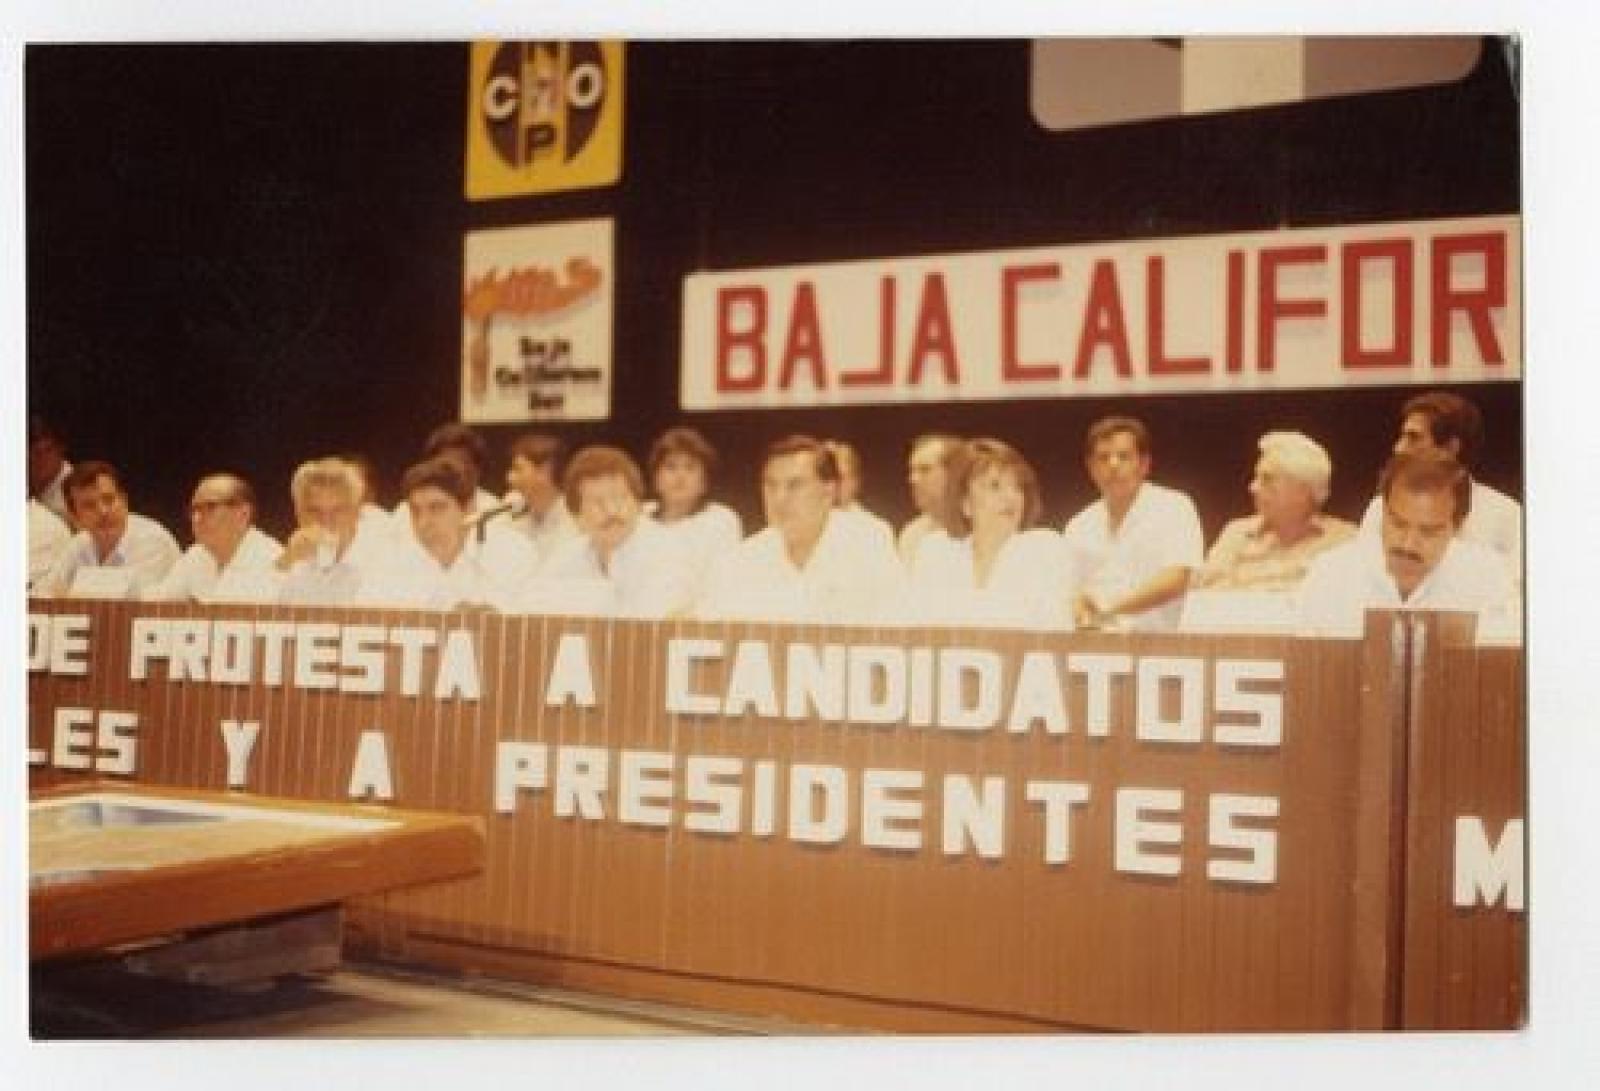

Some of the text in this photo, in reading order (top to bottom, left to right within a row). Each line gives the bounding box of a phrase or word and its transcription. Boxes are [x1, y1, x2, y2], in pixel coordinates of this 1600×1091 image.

[716, 231, 1506, 393] BAJA CALIFOR
[130, 617, 481, 700] PROTESTA
[546, 634, 597, 707] A
[665, 638, 1284, 747] CANDIDATOS
[220, 720, 260, 788] Y
[348, 732, 393, 799] A
[495, 740, 1280, 884] PRESIDENTES
